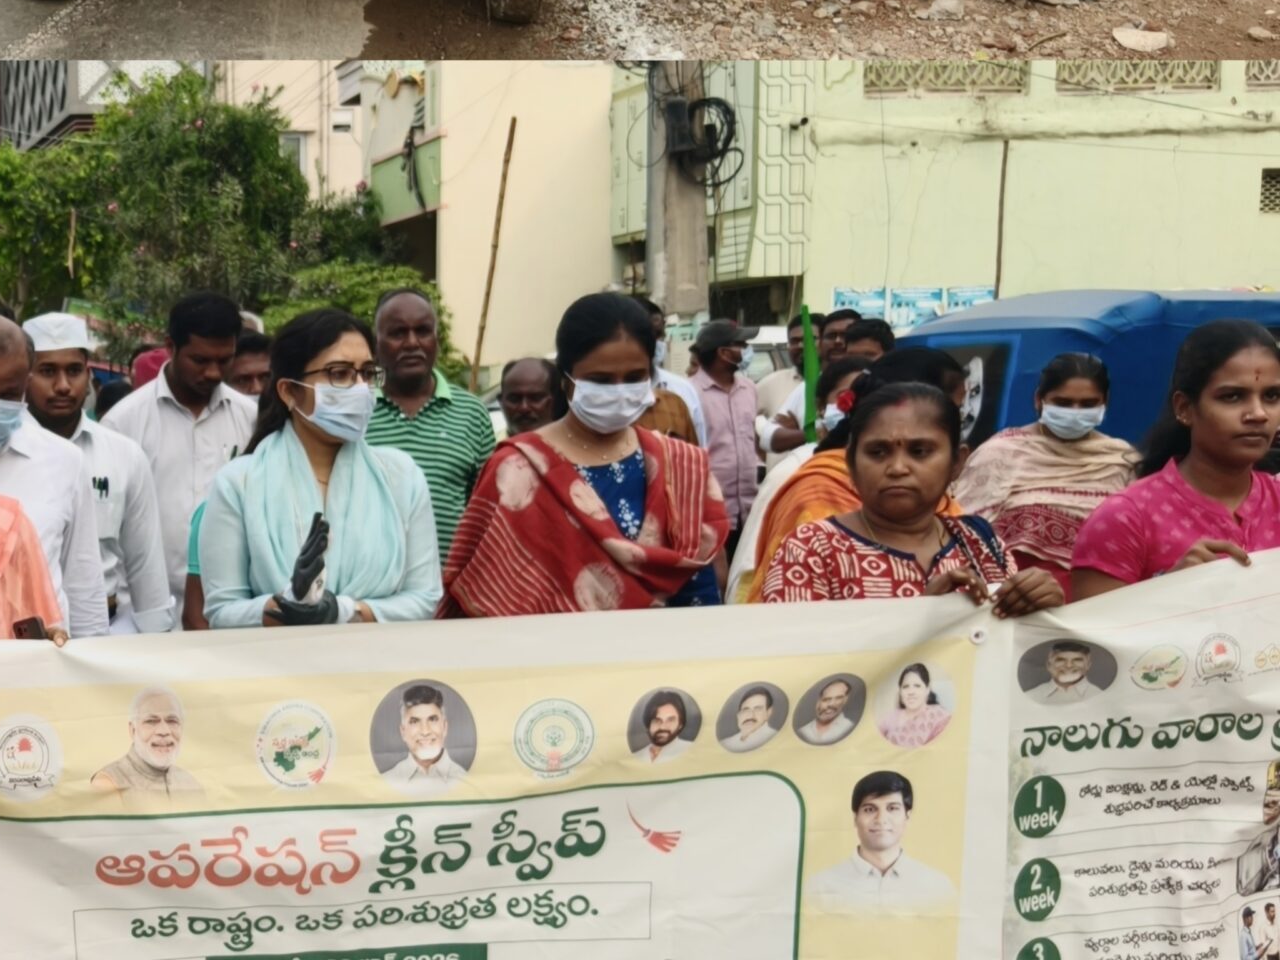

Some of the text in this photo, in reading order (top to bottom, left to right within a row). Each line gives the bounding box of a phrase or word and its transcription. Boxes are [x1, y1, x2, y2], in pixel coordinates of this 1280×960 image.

[1021, 716, 1144, 758] నాలుగు
[1151, 712, 1264, 750] వారాల
[1034, 781, 1043, 808] 1
[1170, 780, 1181, 791] &
[1019, 806, 1059, 832] week
[94, 807, 607, 896] ఆపరేషన్ క్లీన్ స్వీప్
[1154, 858, 1204, 870] మరియు
[1030, 864, 1042, 891] 2
[1018, 890, 1056, 915] week
[130, 890, 599, 951] ఒక రాష్ట్రం. ఒక పరిశుభ్రత లక్ష్యం.
